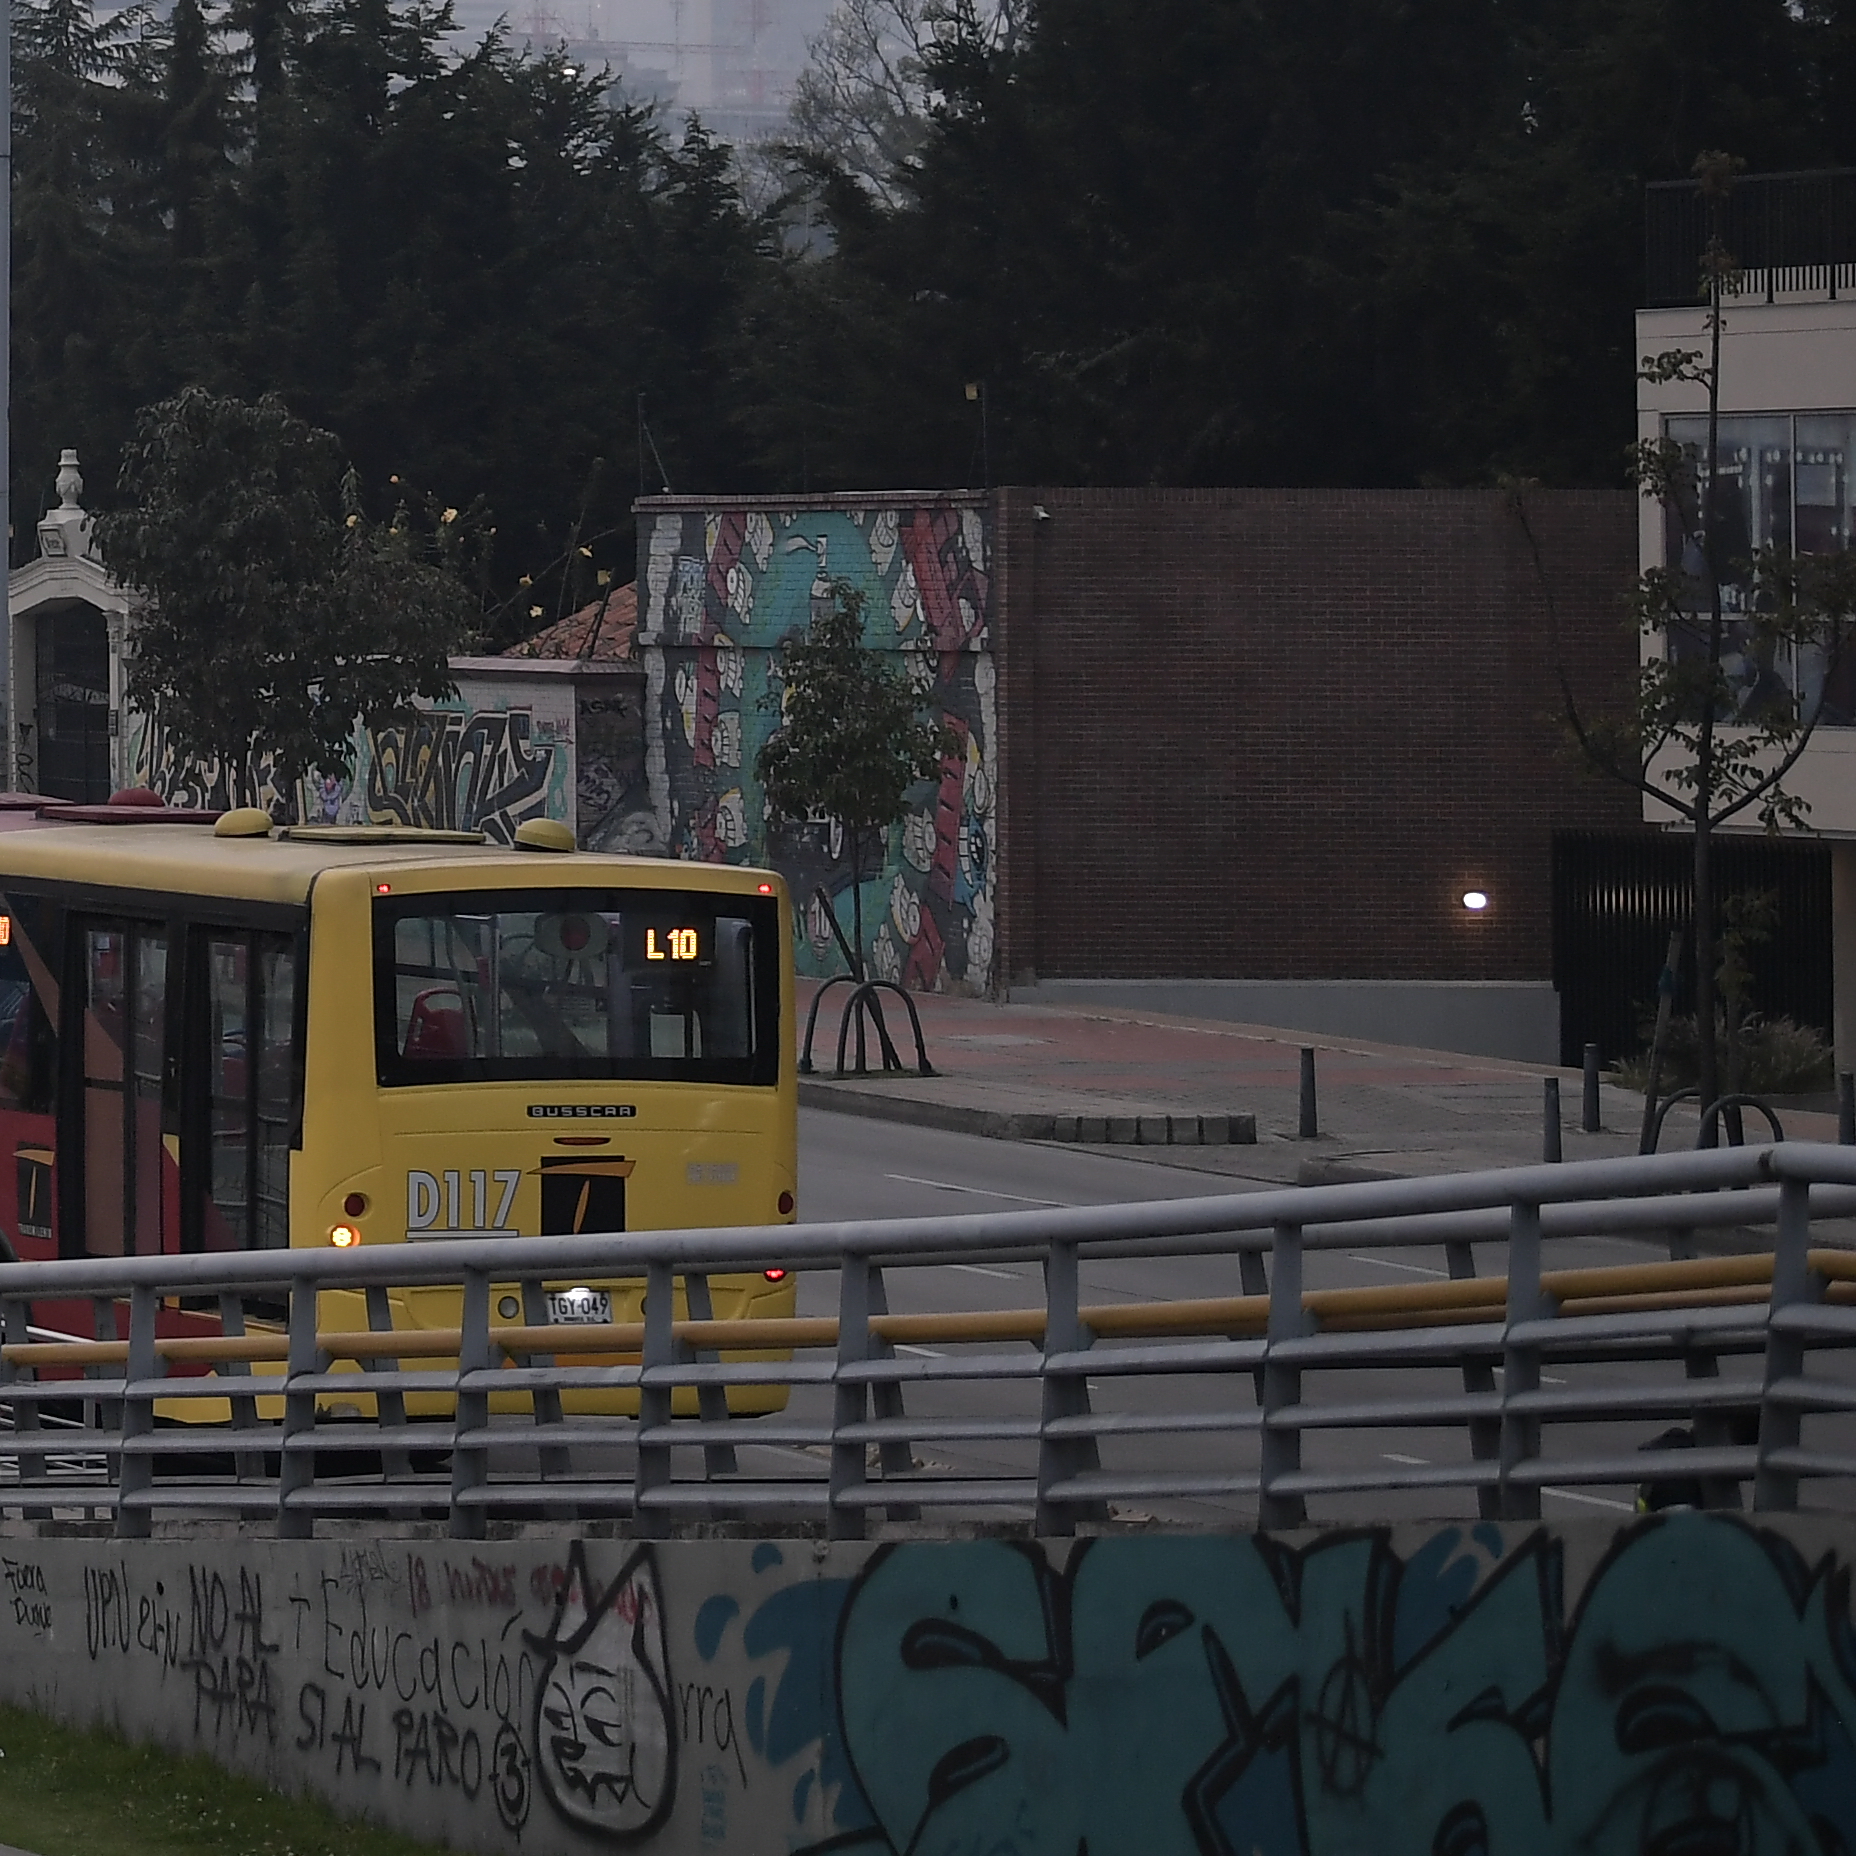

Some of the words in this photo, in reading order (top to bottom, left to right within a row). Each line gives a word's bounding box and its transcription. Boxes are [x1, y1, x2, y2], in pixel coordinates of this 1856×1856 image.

[646, 928, 697, 960] L10
[531, 1106, 632, 1118] BUSSCAR
[406, 1169, 522, 1230] D117
[548, 1296, 609, 1316] TGY-049
[189, 1563, 229, 1656] NO
[234, 1564, 280, 1662] AL
[321, 1551, 535, 1732] Educación
[180, 1655, 277, 1742] PARA
[296, 1682, 326, 1751] SI
[331, 1696, 382, 1776] AL
[392, 1708, 483, 1801] PARO
